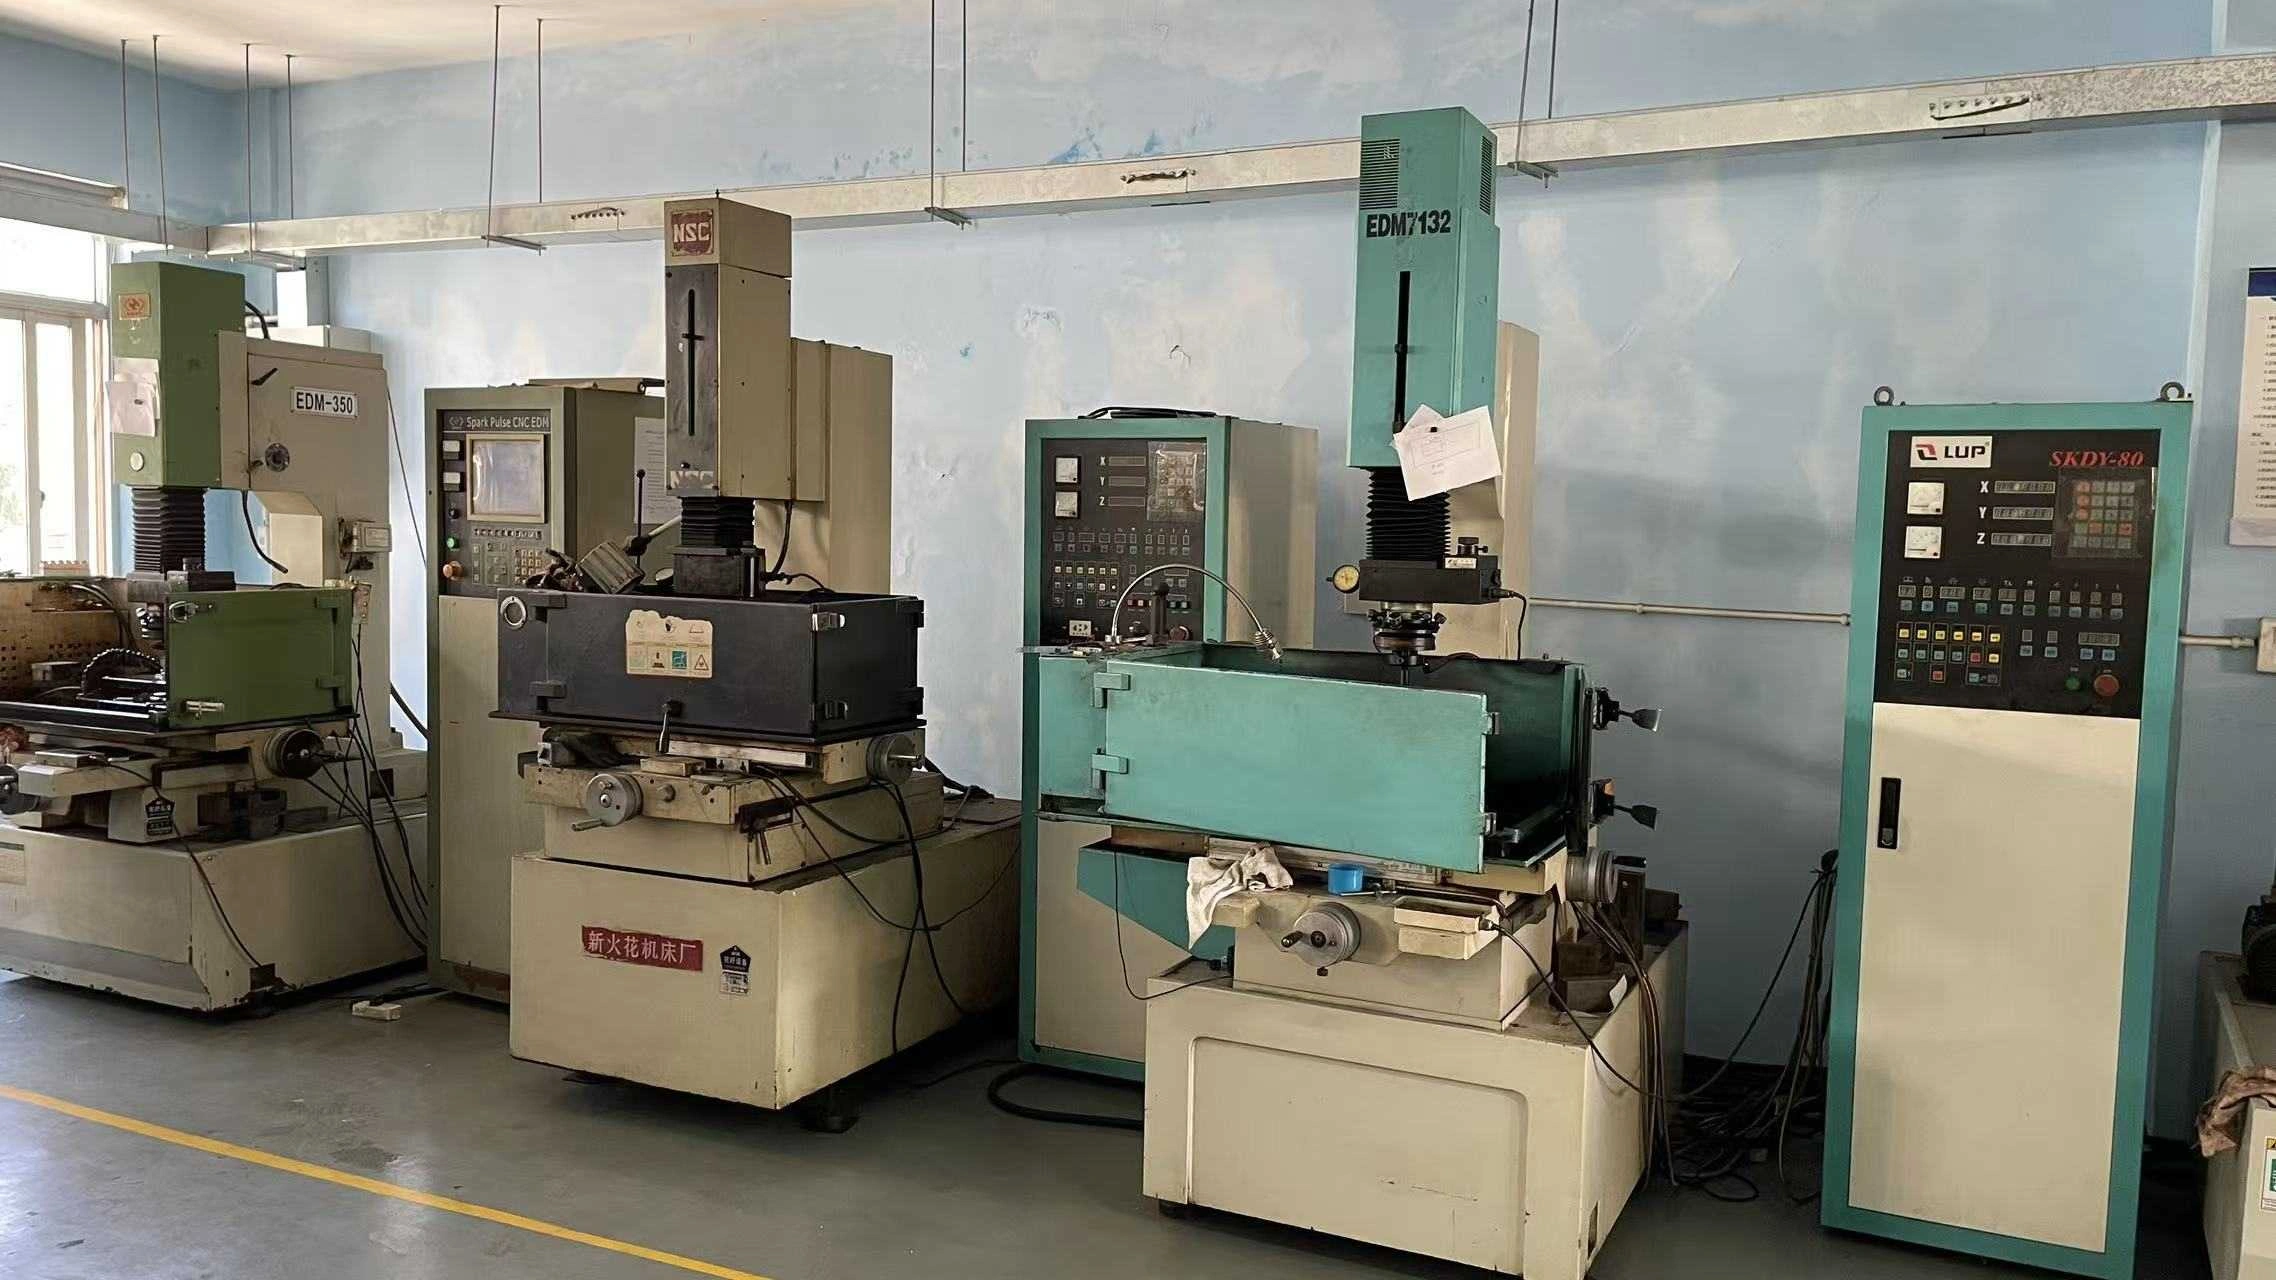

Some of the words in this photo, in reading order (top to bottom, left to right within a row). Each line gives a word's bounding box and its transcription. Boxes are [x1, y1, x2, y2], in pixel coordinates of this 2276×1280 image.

[1366, 209, 1452, 238] EDM7132
[673, 222, 710, 243] NSC
[296, 391, 353, 414] EDM-350
[466, 416, 489, 429] Spark
[490, 416, 512, 428] Pulse
[512, 416, 530, 428] CNC
[531, 416, 550, 428] EDM
[1943, 445, 1986, 459] LUP
[2049, 450, 2145, 467] SKDY-80
[1979, 480, 1989, 493] X
[1978, 506, 1987, 519] Y
[1976, 532, 1986, 545] Z
[587, 930, 697, 963] 新火花机床厂
